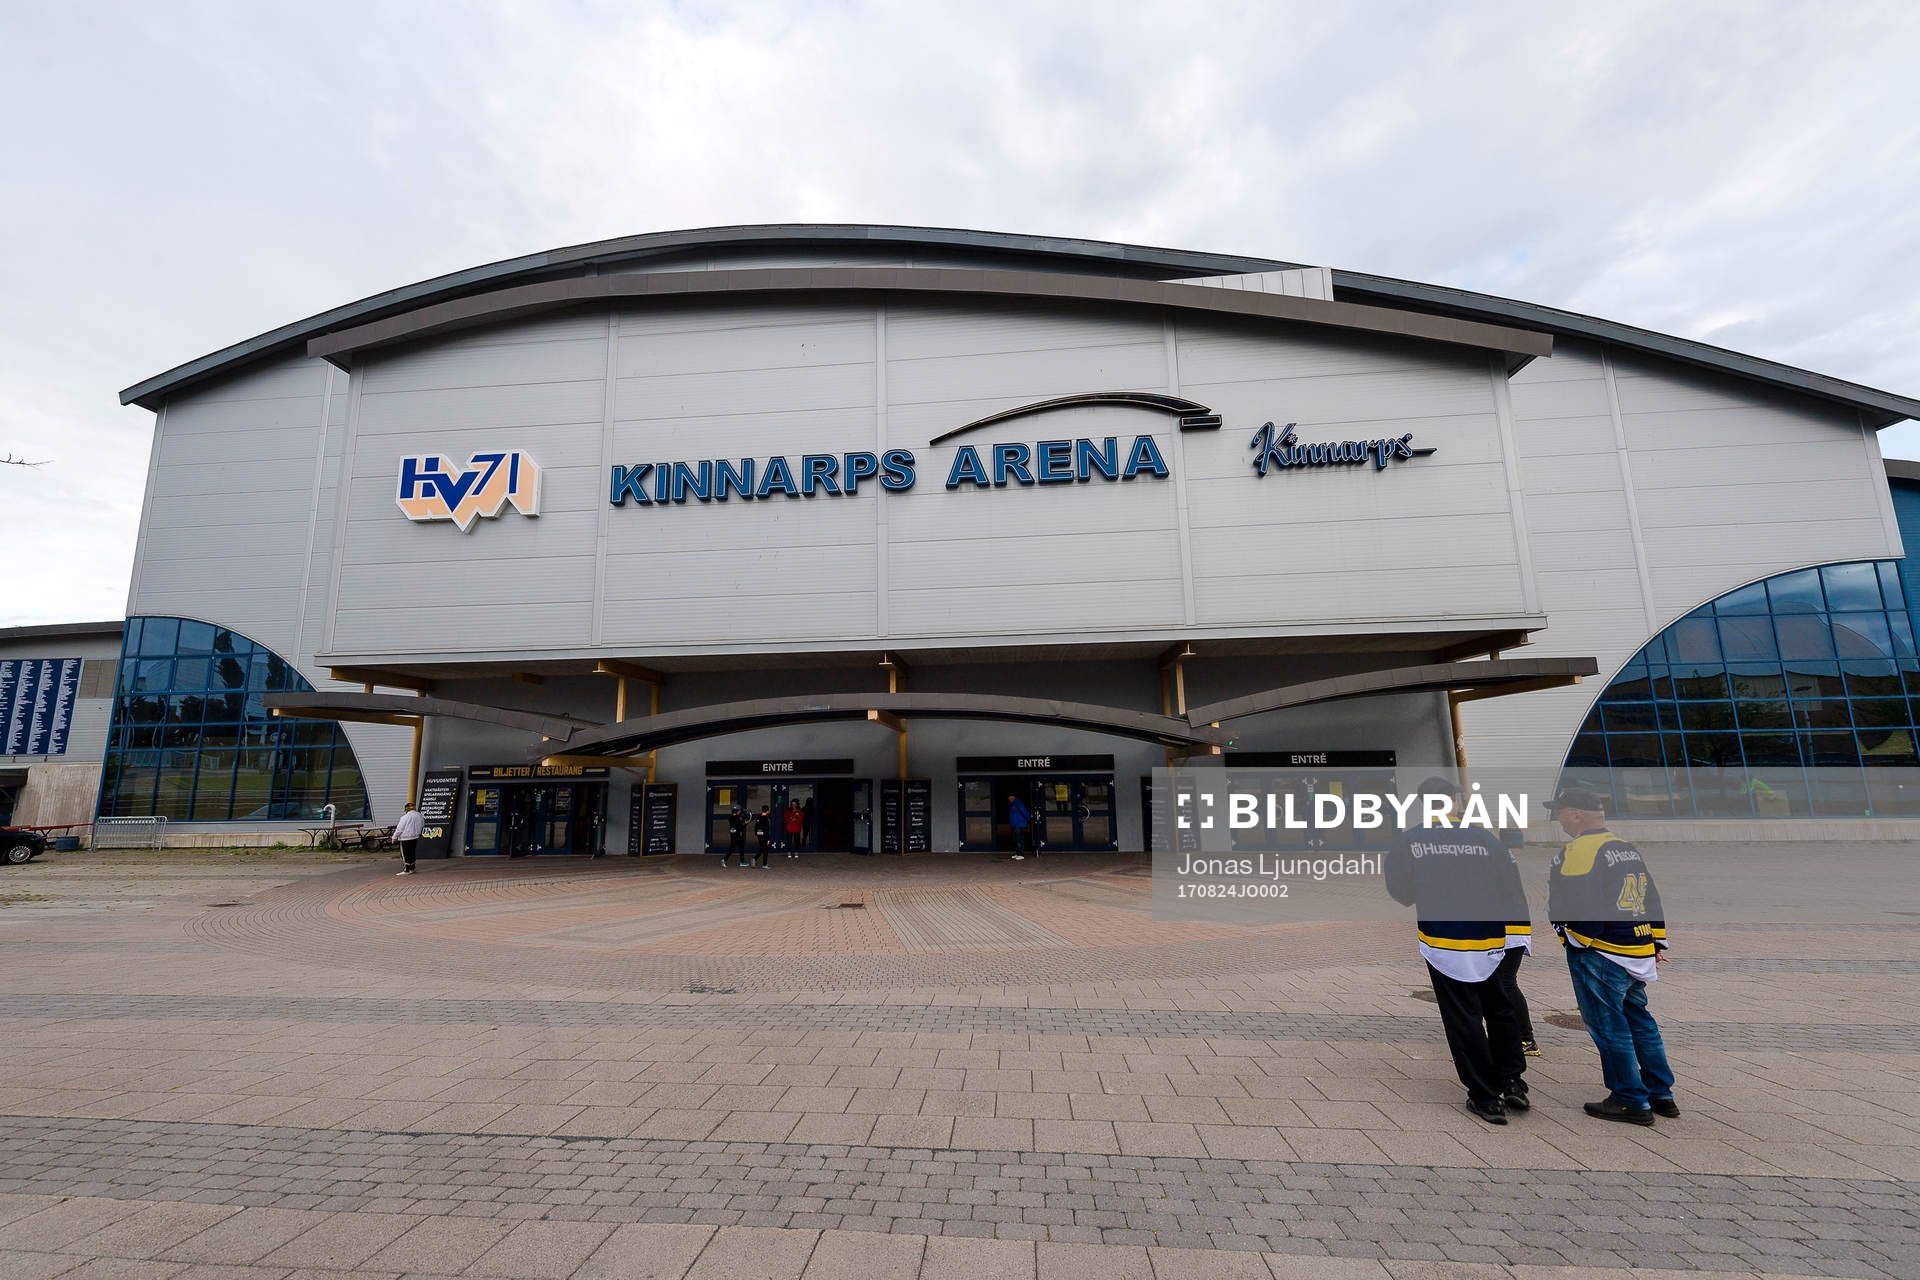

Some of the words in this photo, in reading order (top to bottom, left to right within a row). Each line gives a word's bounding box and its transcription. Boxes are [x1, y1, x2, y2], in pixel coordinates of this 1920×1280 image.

[1250, 421, 1438, 476] Kinnarps
[610, 448, 916, 506] KINNARPS
[945, 435, 1171, 490] ARENA
[398, 450, 524, 517] HV71
[1018, 756, 1051, 768] ENTRÉ
[1291, 753, 1327, 764] ENTRÉ
[493, 767, 530, 777] BILJETTER
[537, 766, 583, 776] RESTAURANG
[762, 761, 794, 772] ENTRÉ
[1422, 842, 1490, 857] Husqvarn
